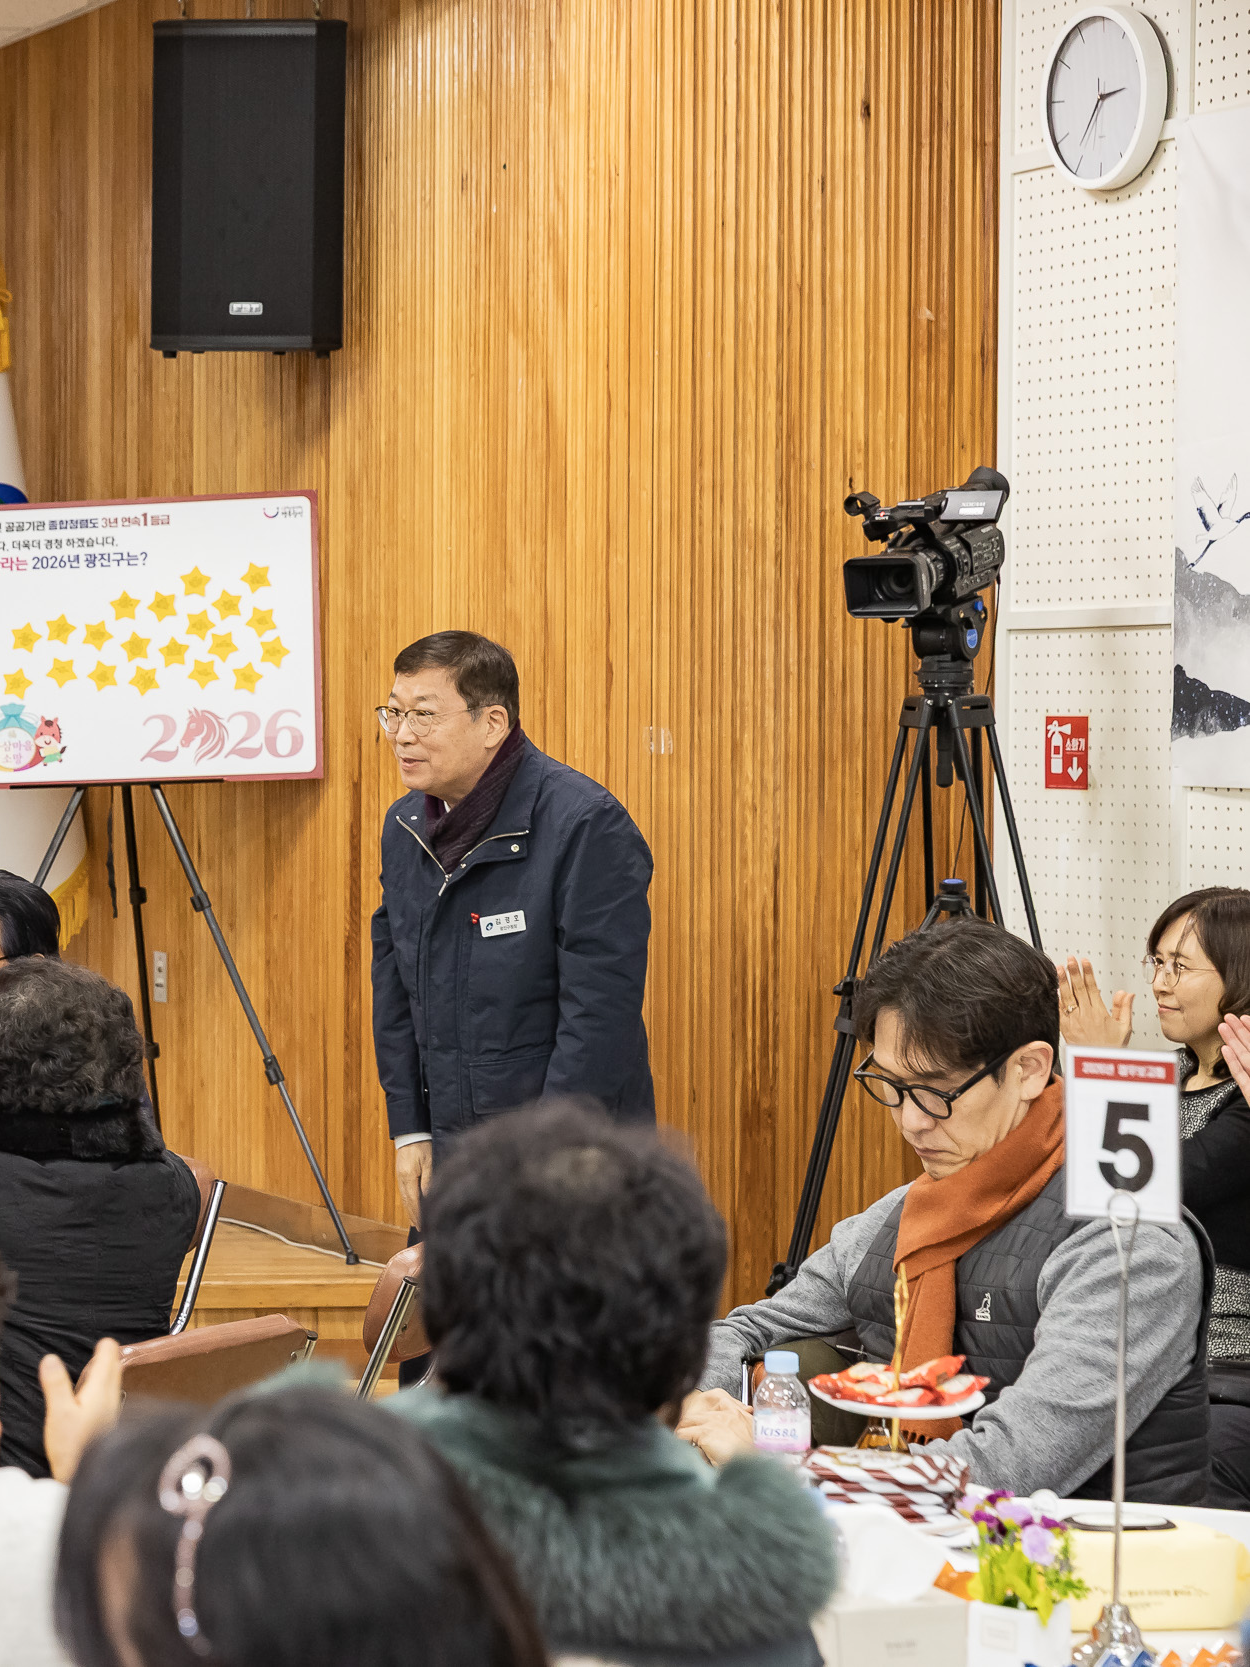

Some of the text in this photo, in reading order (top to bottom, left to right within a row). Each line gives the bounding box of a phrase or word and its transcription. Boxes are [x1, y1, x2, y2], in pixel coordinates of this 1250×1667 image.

[5, 520, 46, 532] 공공기관
[101, 516, 119, 528] 3년
[12, 539, 41, 551] 더욱더
[44, 538, 63, 550] 경청
[65, 536, 119, 549] 하겠습니다.
[32, 553, 80, 570] 2026년
[84, 551, 148, 568] 광진구는?
[1098, 1101, 1154, 1193] 5
